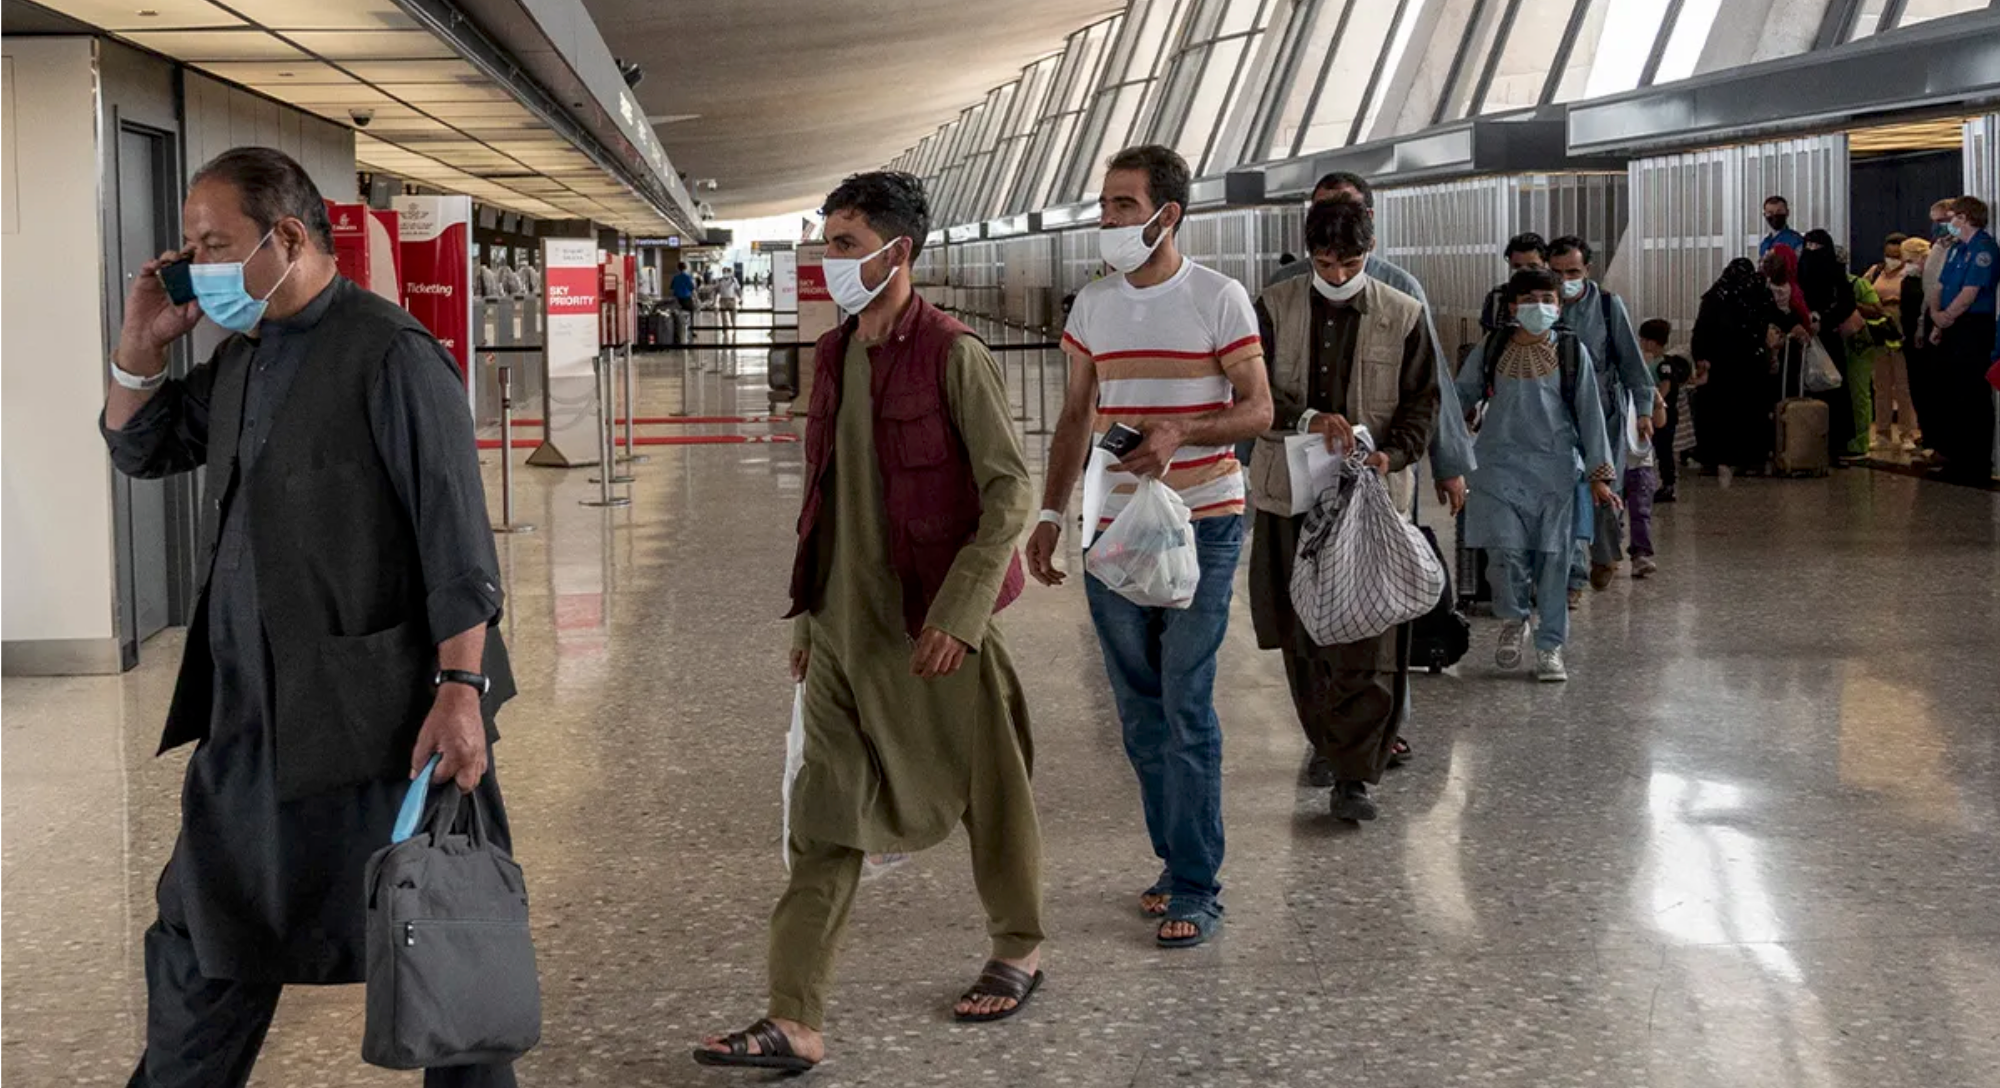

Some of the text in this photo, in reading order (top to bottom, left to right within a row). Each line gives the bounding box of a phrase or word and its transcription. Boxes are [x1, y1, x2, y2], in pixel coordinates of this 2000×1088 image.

[406, 282, 453, 297] Ticketing
[549, 285, 569, 295] SKY
[549, 295, 595, 306] PRIORITY
